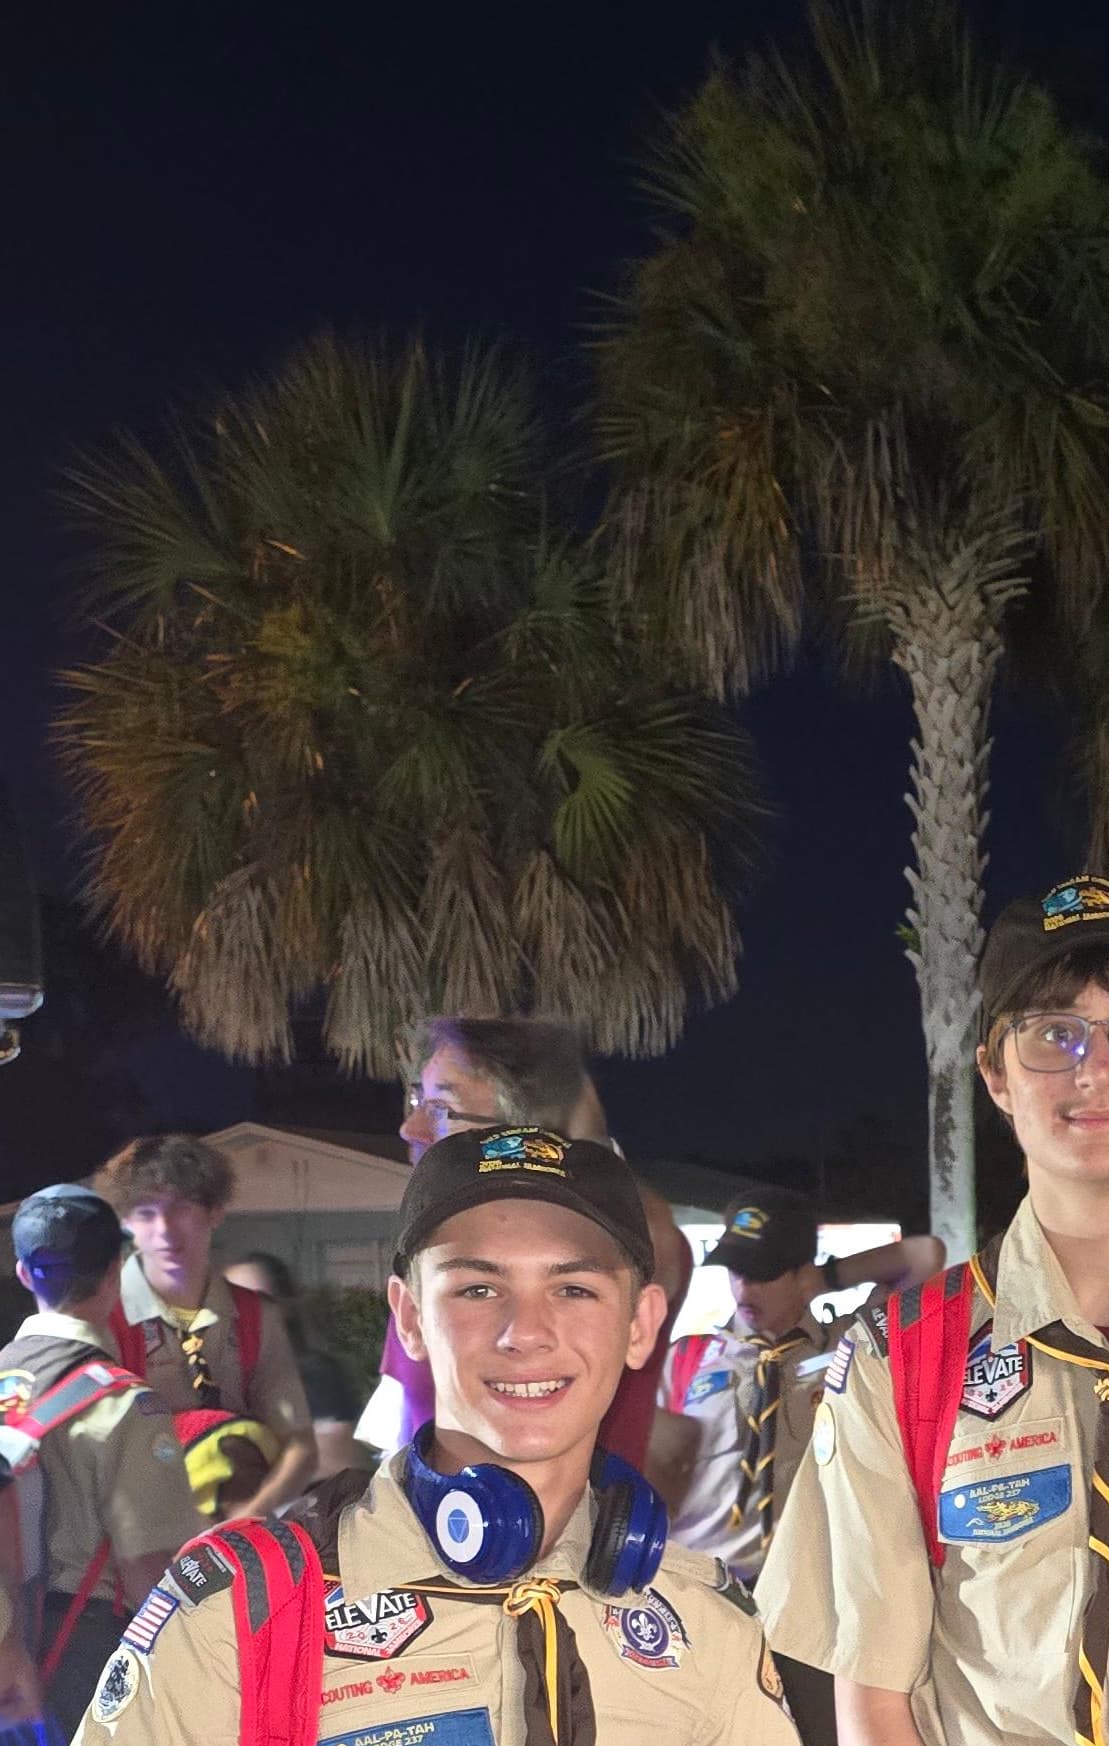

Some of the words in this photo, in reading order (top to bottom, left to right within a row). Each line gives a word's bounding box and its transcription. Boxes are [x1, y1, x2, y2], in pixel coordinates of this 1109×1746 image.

[962, 1355, 1024, 1386] LEVATE
[325, 1590, 417, 1631] ELEVATE
[320, 1680, 374, 1707] COUTING
[409, 1668, 471, 1686] AMERICA
[404, 1734, 424, 1746] 237
